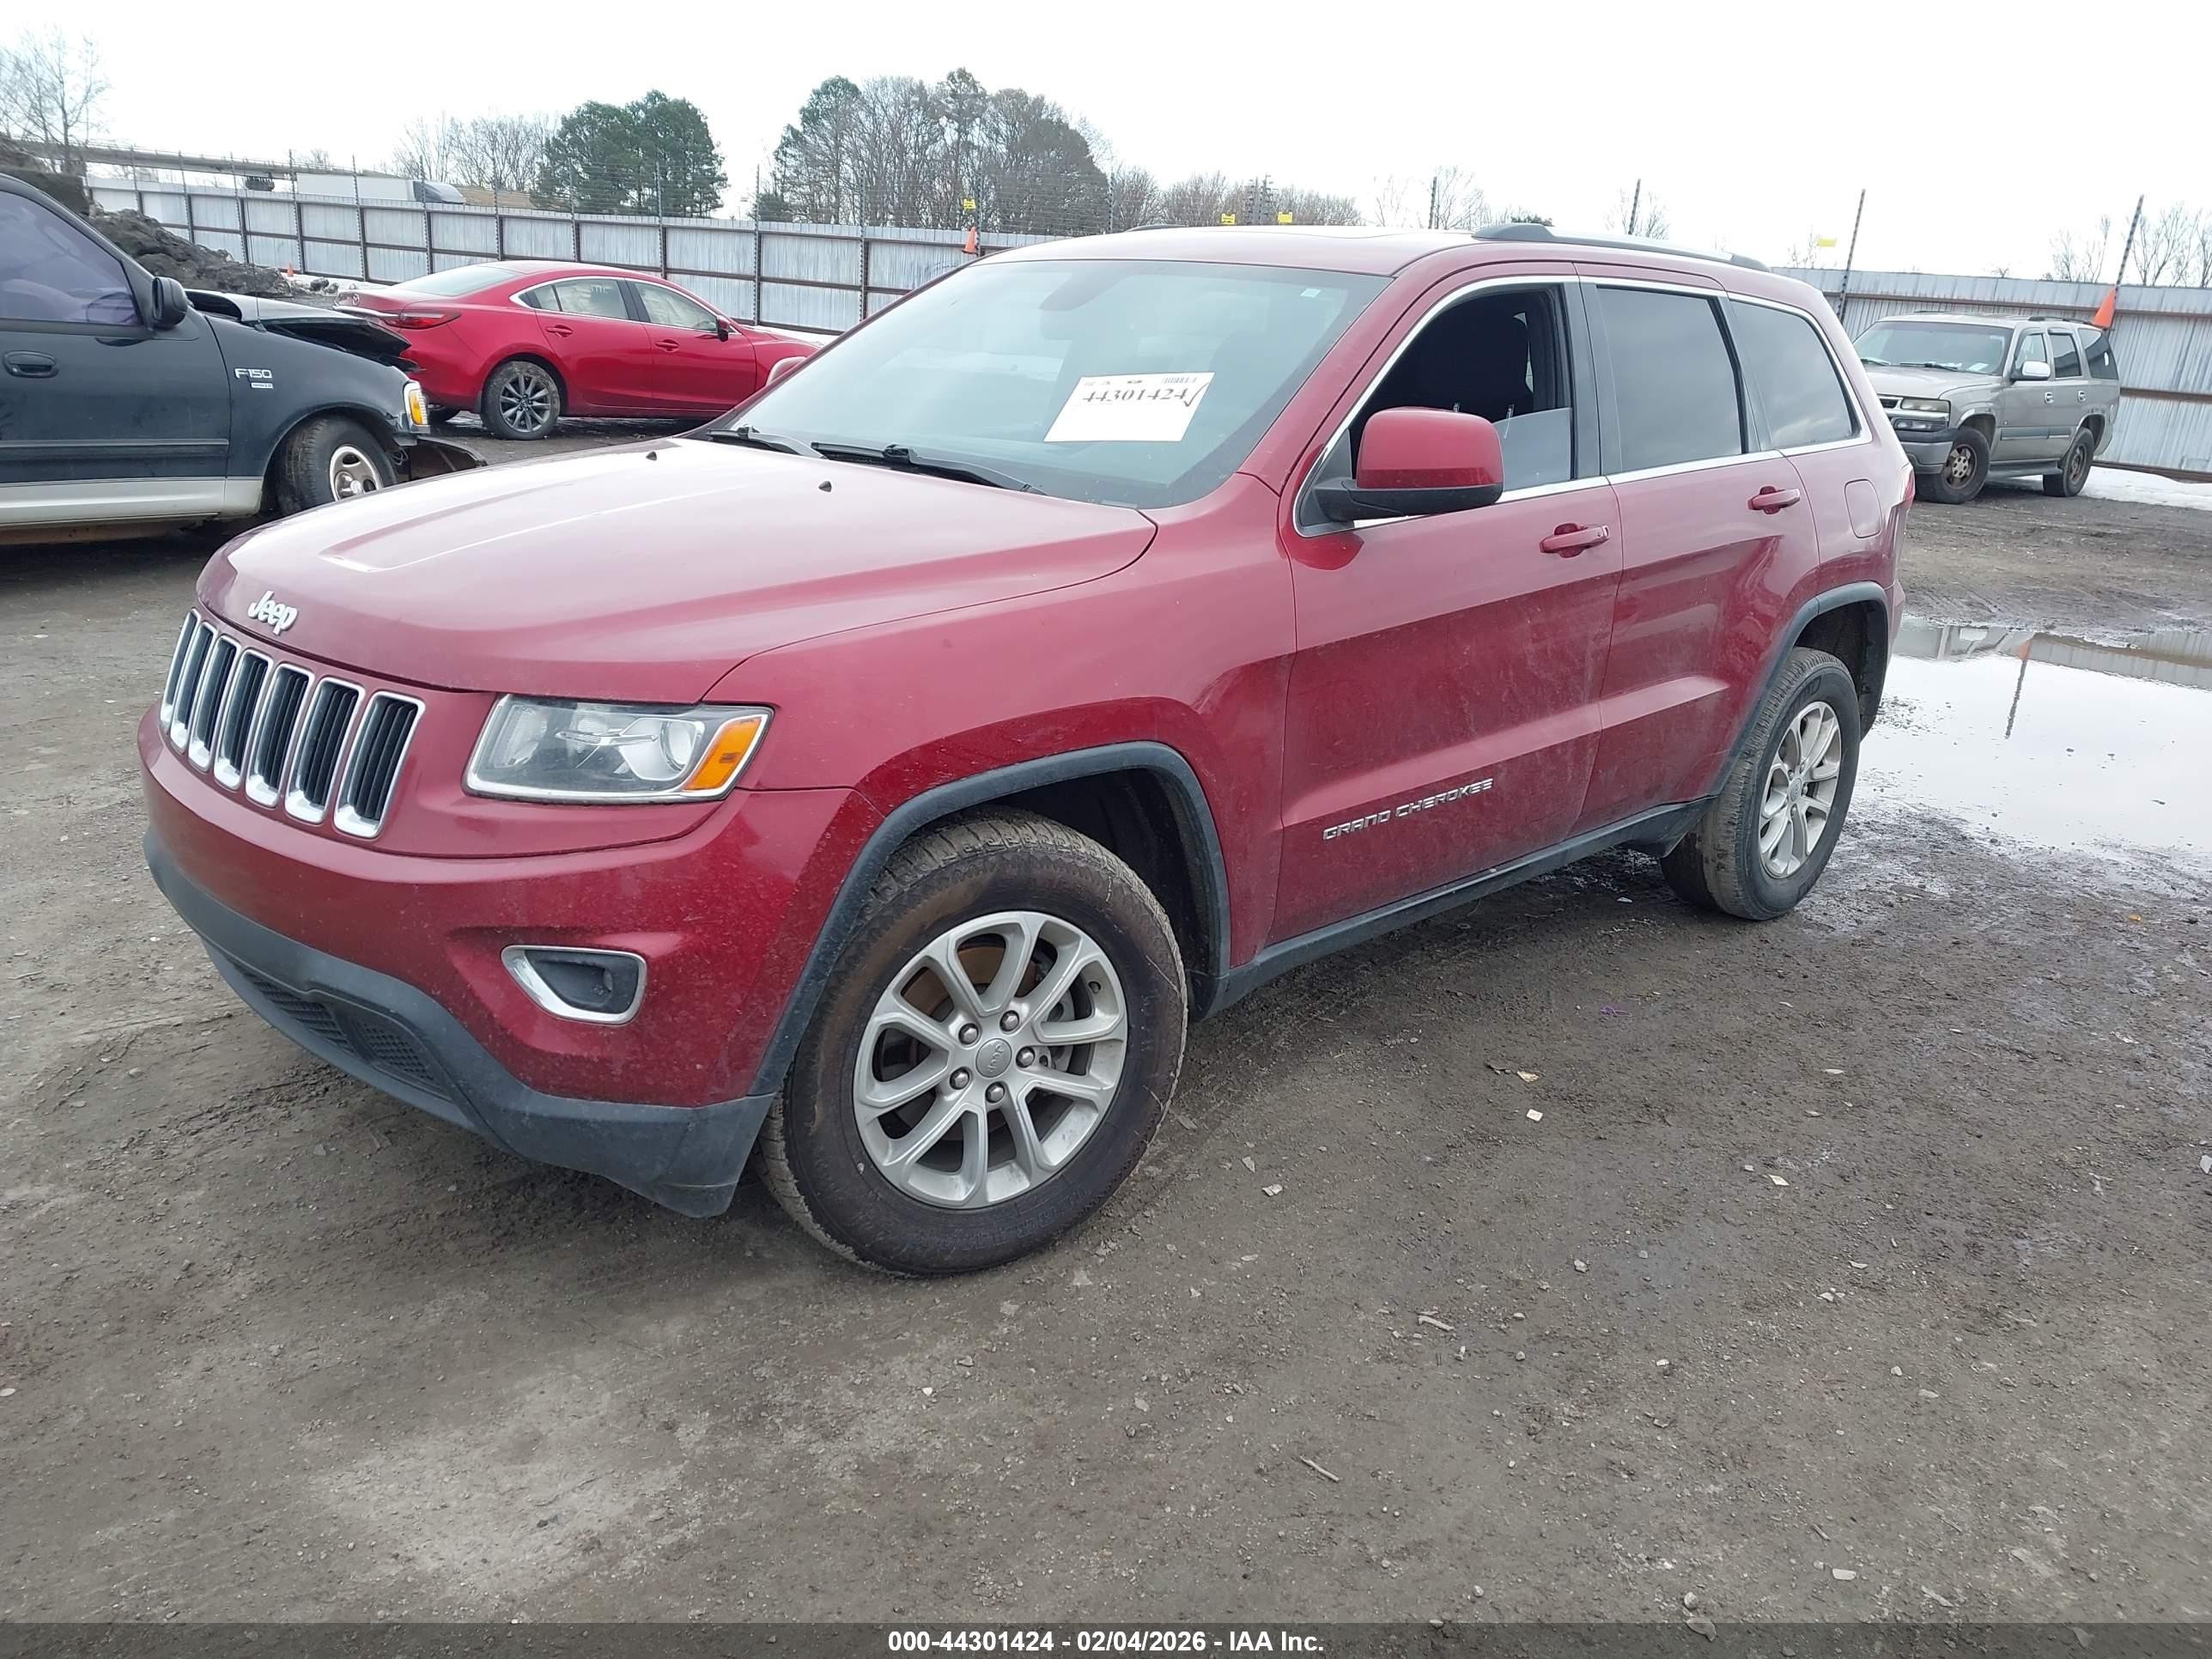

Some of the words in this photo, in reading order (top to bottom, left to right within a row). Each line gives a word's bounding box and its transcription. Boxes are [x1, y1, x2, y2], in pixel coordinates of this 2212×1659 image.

[1083, 388, 1188, 402] 44301424
[247, 590, 298, 635] Jeep
[1322, 810, 1391, 841] GRAND
[1395, 778, 1493, 817] CHEROKEE
